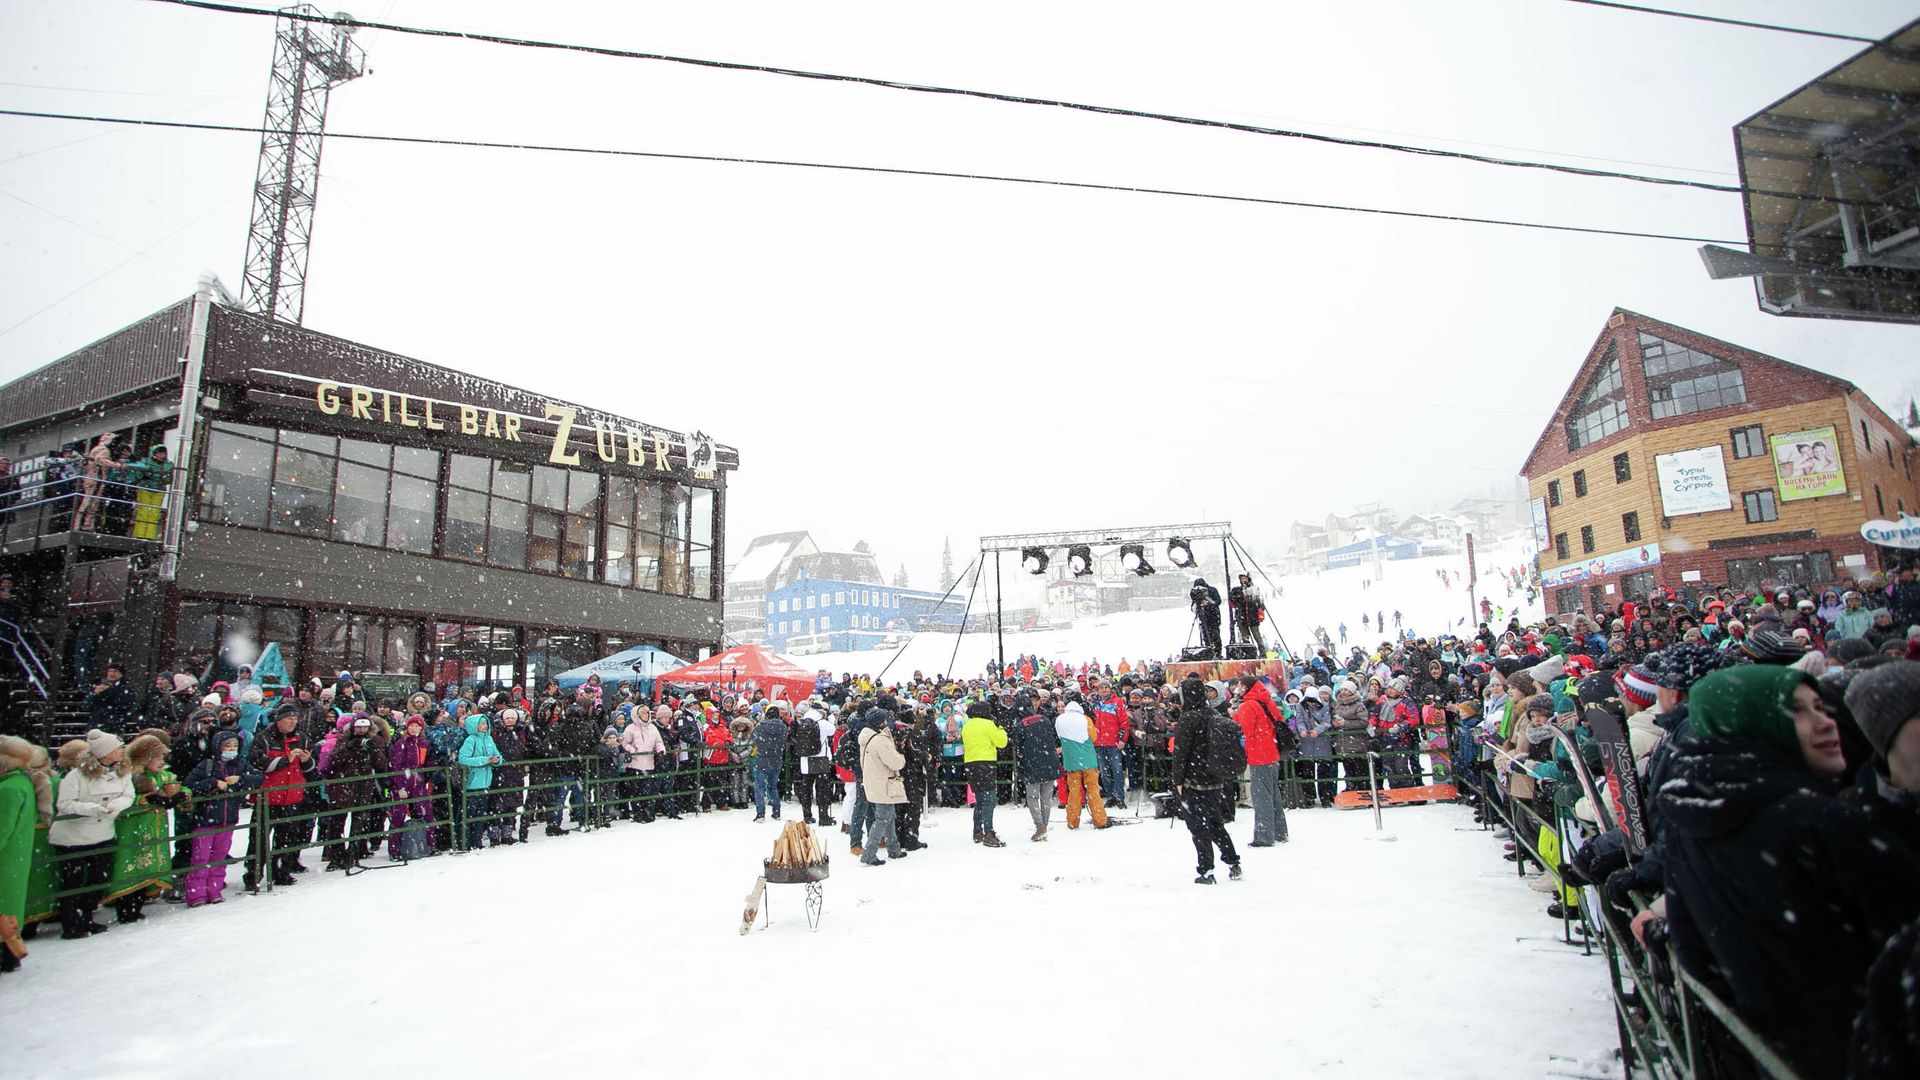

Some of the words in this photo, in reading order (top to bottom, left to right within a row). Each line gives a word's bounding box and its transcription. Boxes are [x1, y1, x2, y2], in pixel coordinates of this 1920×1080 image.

[317, 382, 444, 431] GRILL
[461, 405, 522, 443] BAR
[545, 404, 672, 472] ZUBR
[1676, 467, 1705, 477] Туры
[1816, 472, 1838, 482] БАНЬ
[1682, 474, 1713, 484] отель
[1674, 481, 1714, 492] Сугроб
[1614, 742, 1647, 851] SALOMON
